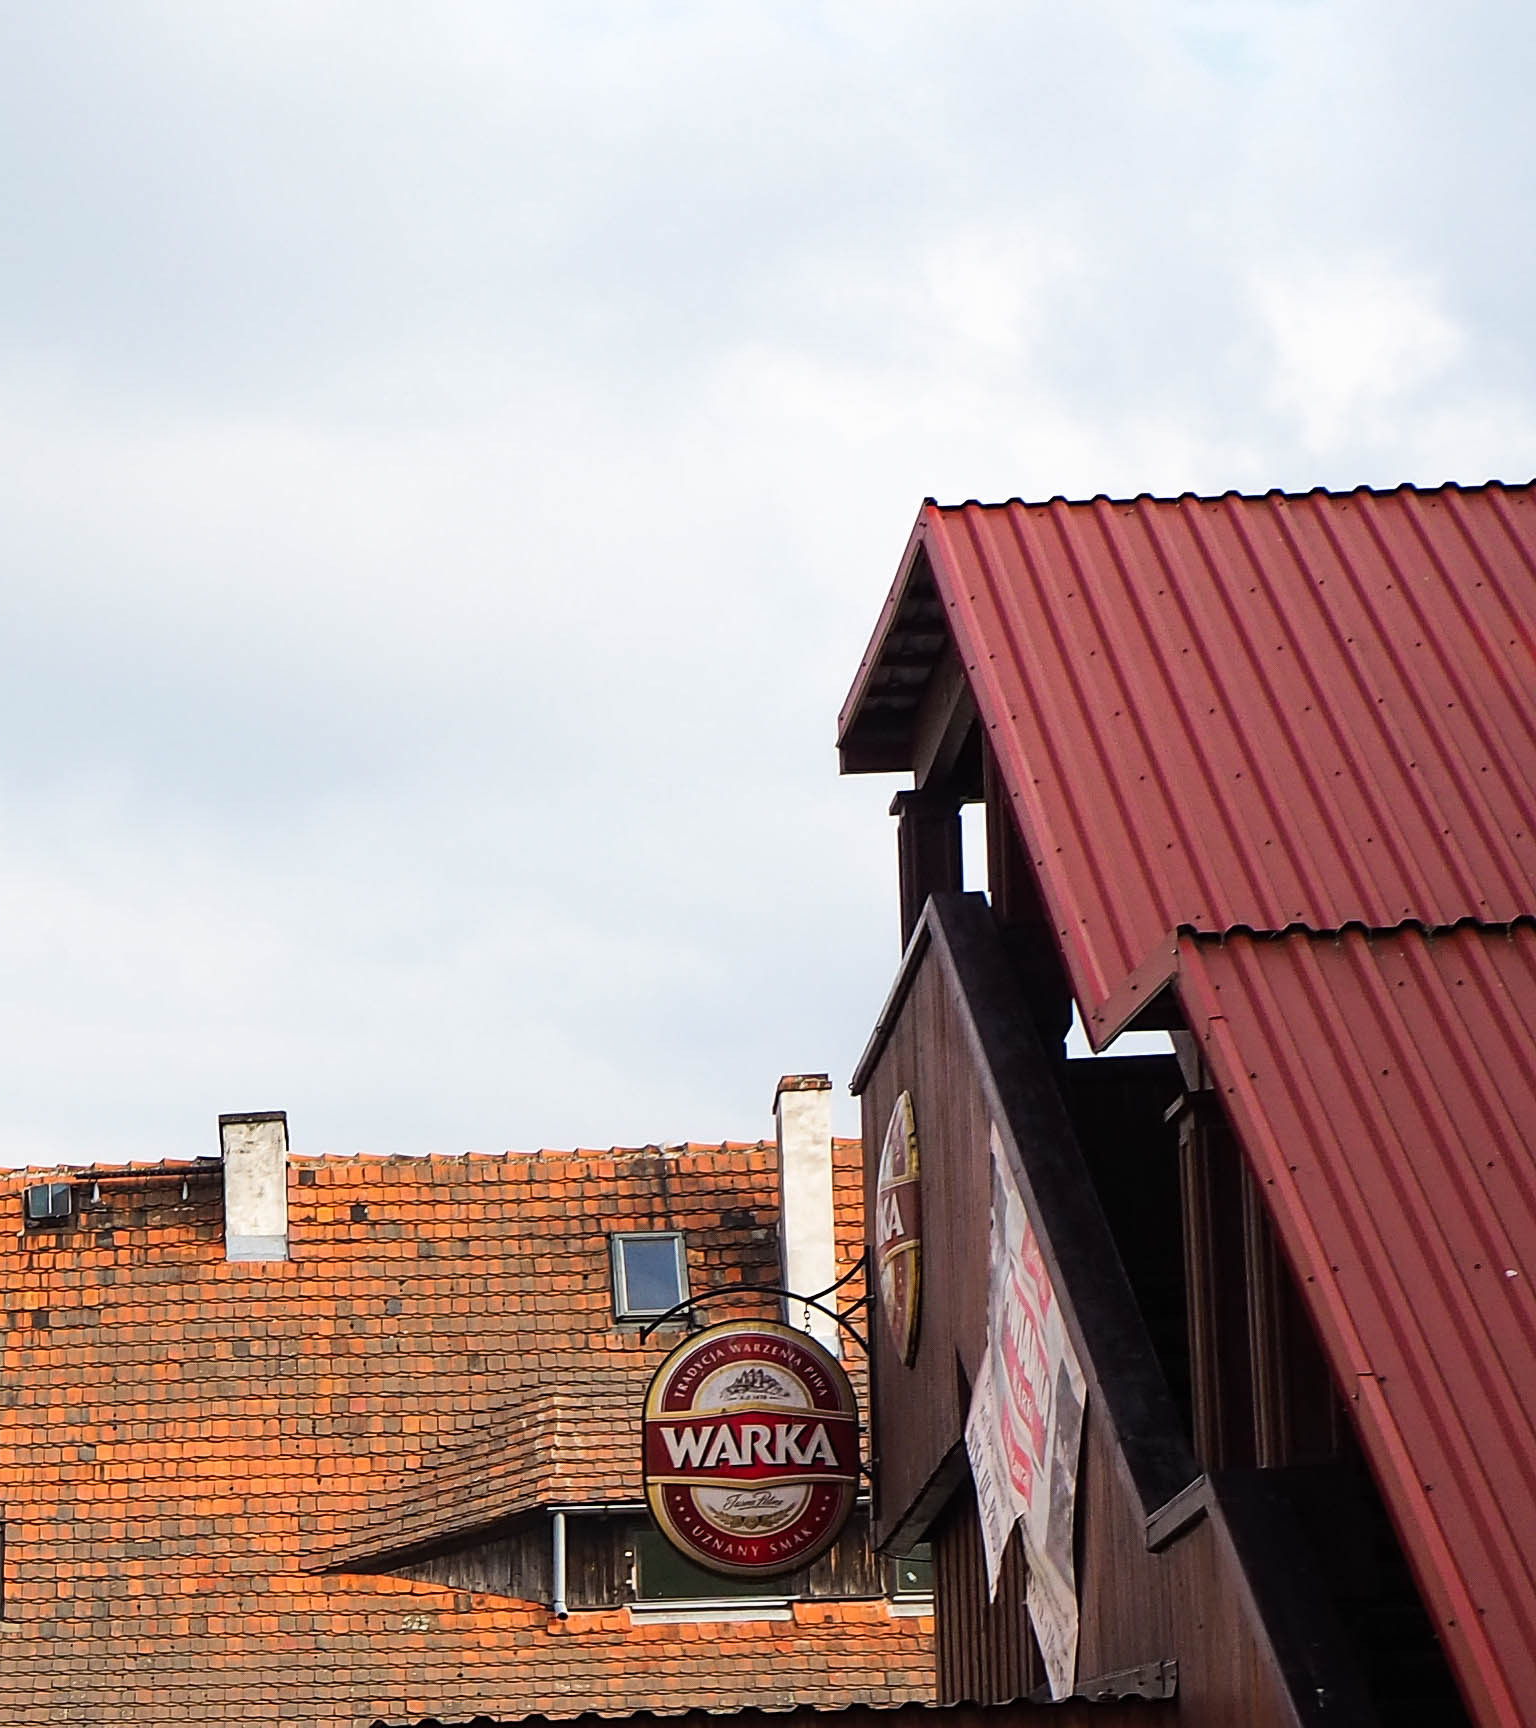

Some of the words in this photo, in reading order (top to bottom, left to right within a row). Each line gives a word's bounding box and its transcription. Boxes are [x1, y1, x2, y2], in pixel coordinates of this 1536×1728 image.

[673, 1349, 726, 1398] TRADYCJA
[729, 1343, 801, 1366] WARZENIA
[804, 1365, 828, 1397] PIWA
[659, 1423, 839, 1468] WARKA
[691, 1525, 760, 1557] UZNANY
[769, 1527, 813, 1555] SMAK
